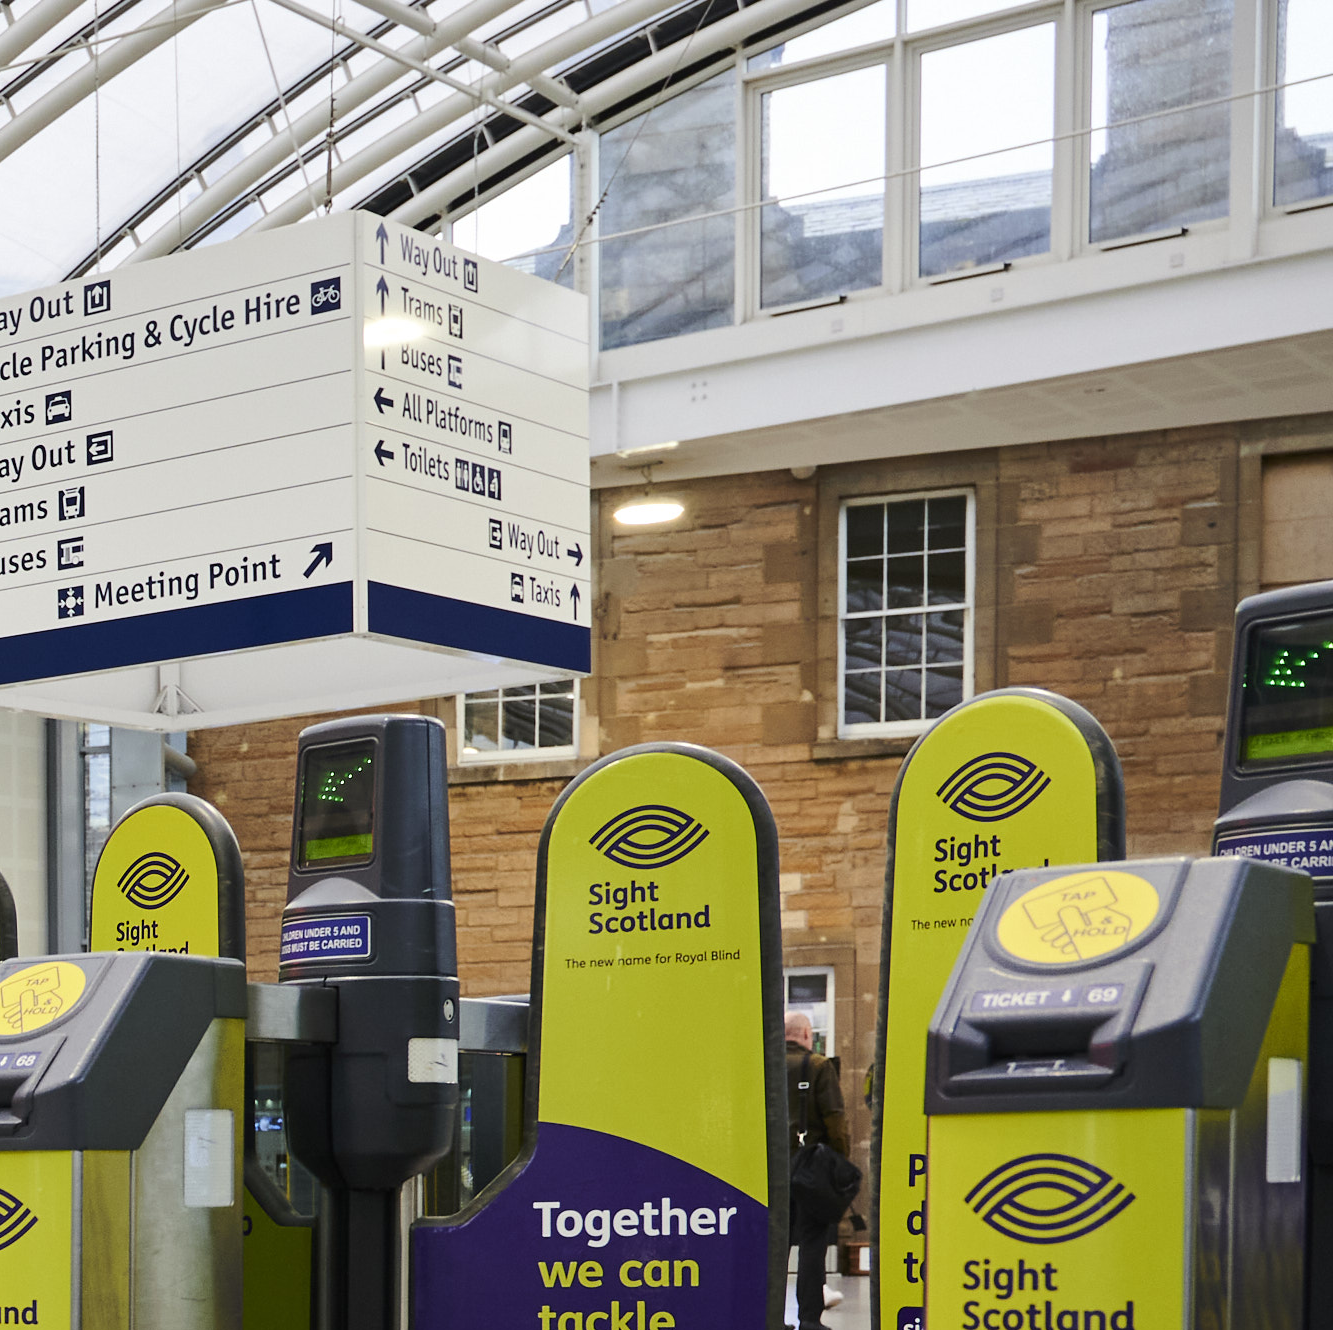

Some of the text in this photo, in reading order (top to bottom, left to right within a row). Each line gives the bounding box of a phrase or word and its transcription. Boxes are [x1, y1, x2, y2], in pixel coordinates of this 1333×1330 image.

[400, 232, 459, 281] Way Out
[29, 290, 75, 324] Out
[401, 285, 444, 326] Trams
[40, 328, 136, 372] Parking
[144, 320, 162, 348] &
[169, 305, 235, 347] Cycle
[244, 292, 301, 326] Hire
[401, 342, 443, 377] Buses
[402, 391, 494, 444] All Platforms
[31, 440, 76, 472] Out
[402, 442, 450, 482] Toilets
[508, 521, 561, 560] Way Out
[94, 553, 282, 609] Meeting Point
[529, 575, 561, 608] Taxis
[934, 834, 1001, 866] Sight
[1263, 840, 1317, 857] UNDER 5
[588, 879, 659, 911] Sight
[1061, 891, 1097, 902] TAP
[116, 918, 159, 946] Sight
[304, 924, 361, 939] UNDER AND
[588, 904, 711, 935] Scotland
[911, 918, 957, 931] The new
[1073, 926, 1128, 938] HOLD
[309, 938, 363, 951] BE CARRIED
[565, 949, 741, 969] The new name for Royal Blind
[25, 977, 50, 987] TAP
[982, 988, 1119, 1008] TICKET 69
[23, 1006, 59, 1017] HOLD
[15, 1054, 37, 1067] 68
[533, 1197, 738, 1248] Together
[537, 1259, 700, 1289] we can
[962, 1259, 1059, 1300] Sight
